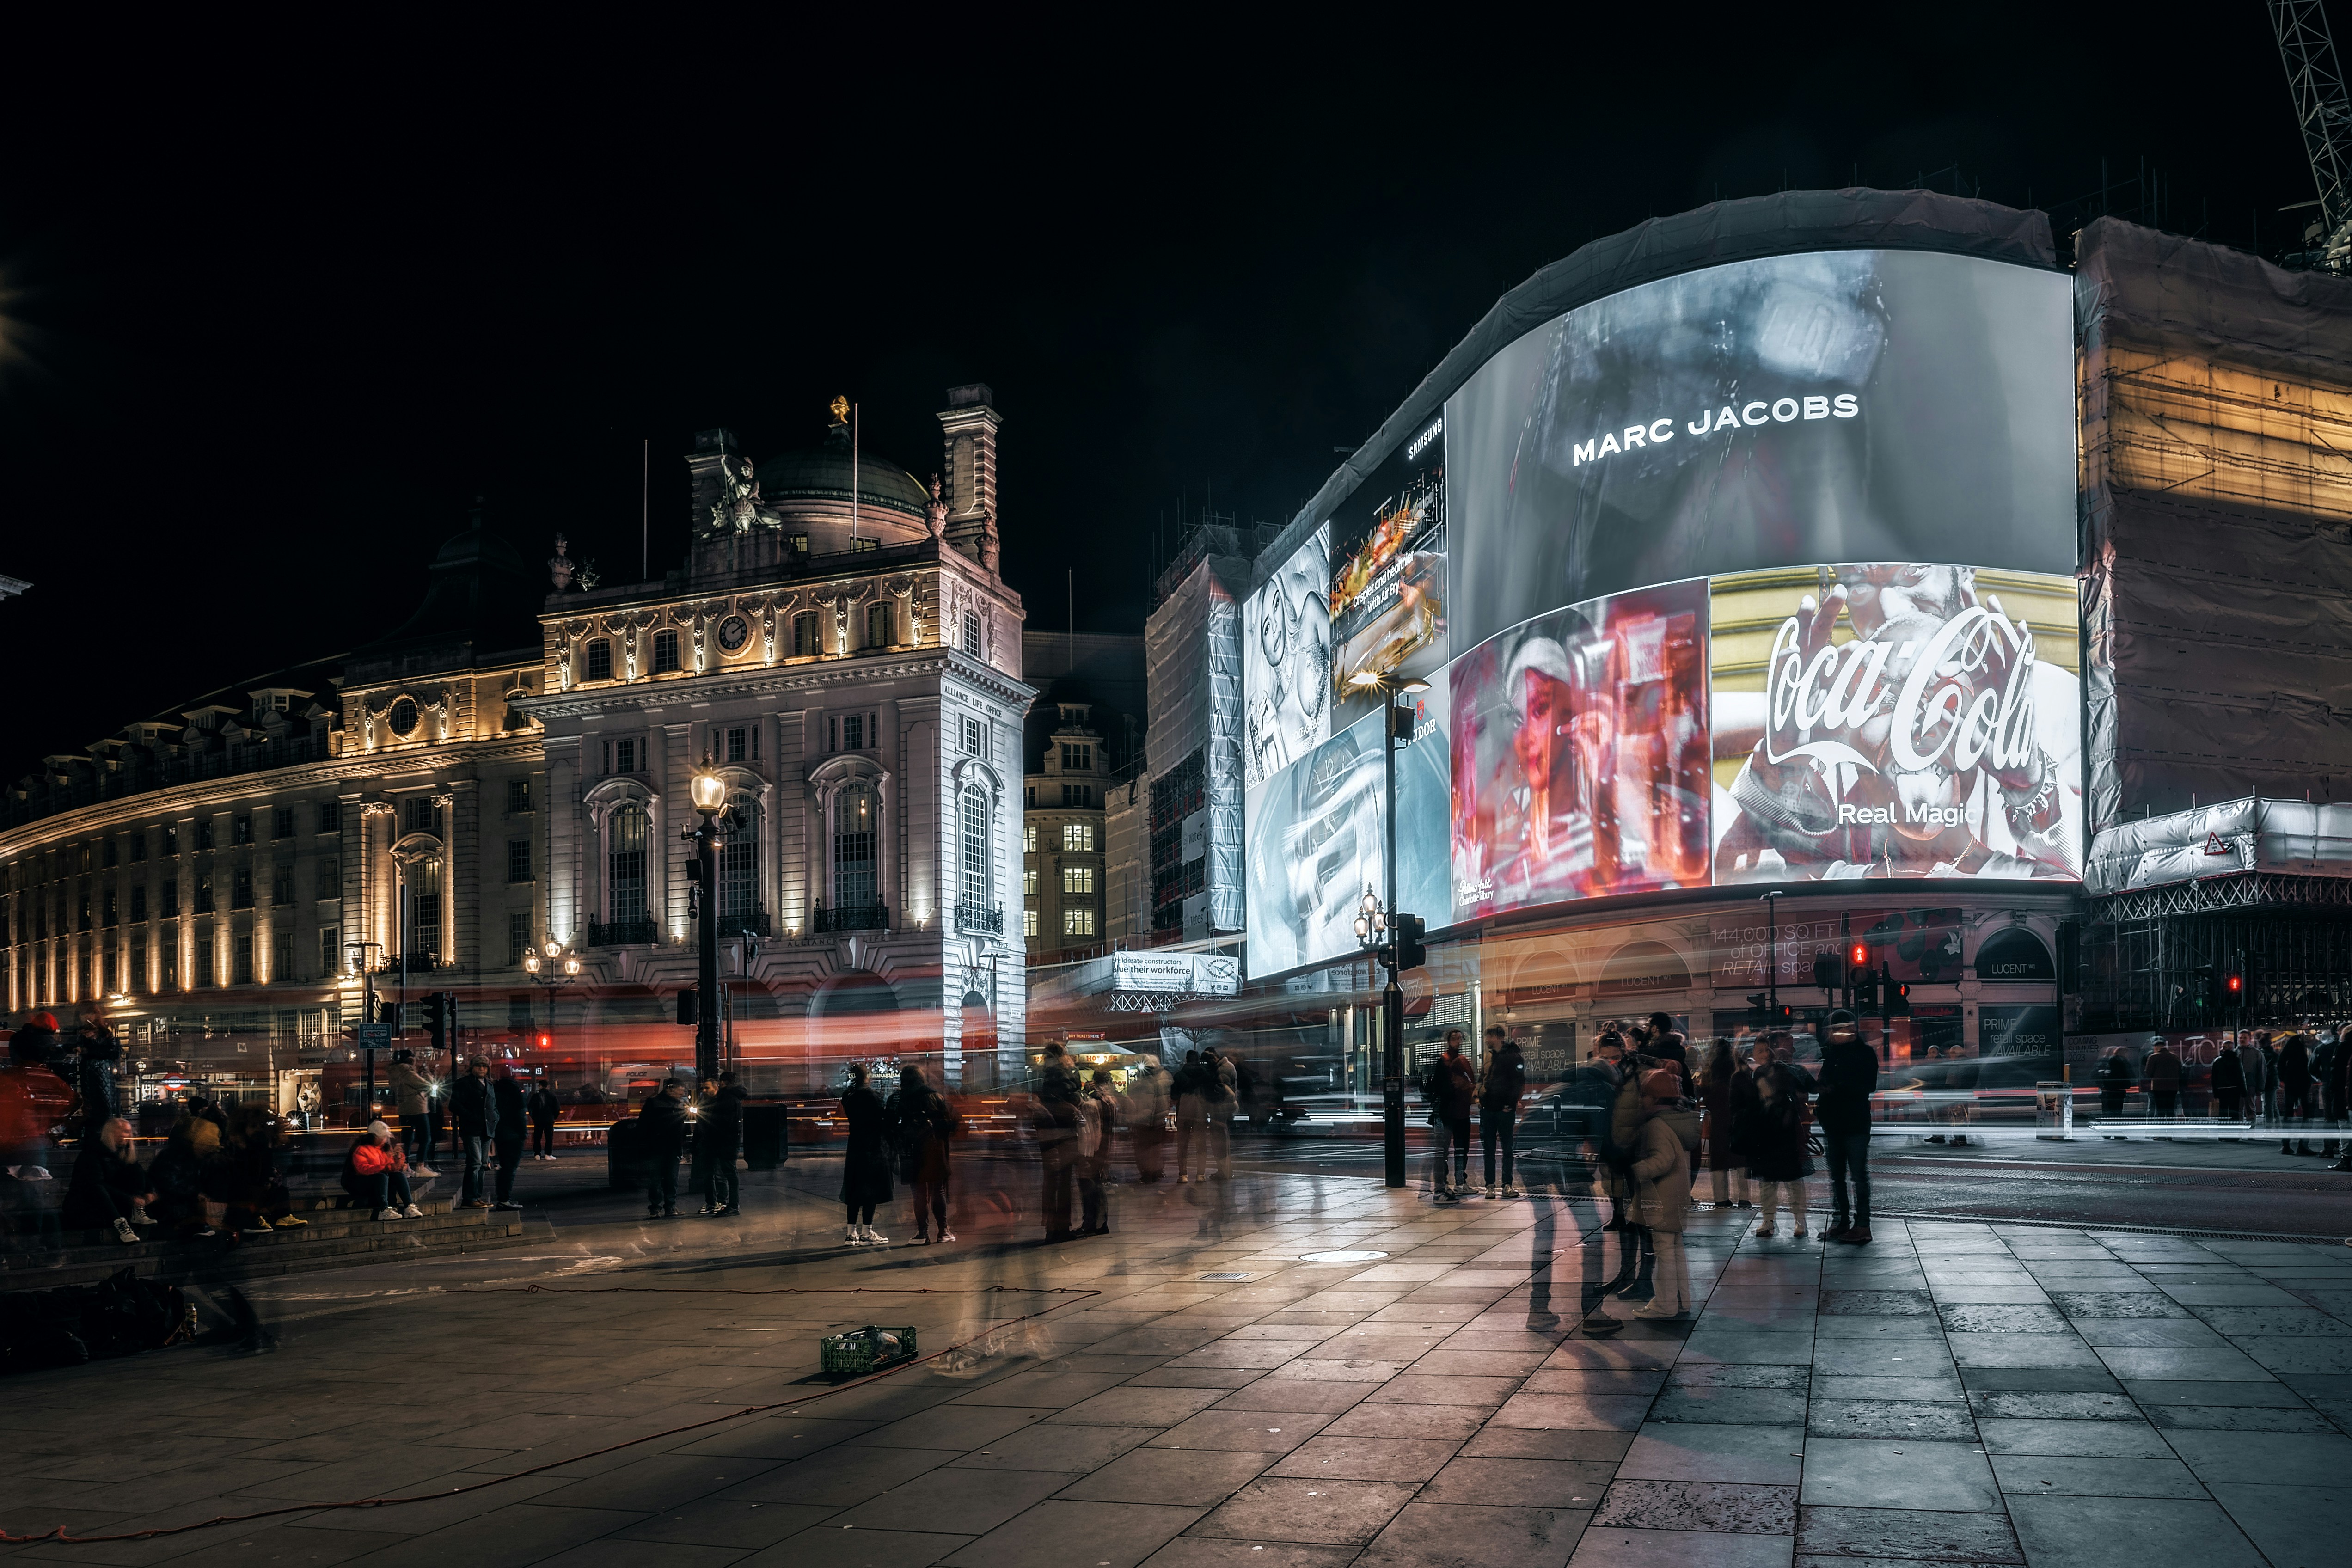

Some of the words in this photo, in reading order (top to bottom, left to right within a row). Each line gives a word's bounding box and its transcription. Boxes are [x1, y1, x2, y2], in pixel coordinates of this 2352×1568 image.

[1573, 418, 1675, 467] MARC
[1687, 394, 1859, 435] JACOBS
[1409, 417, 1442, 460] SAMSUNG
[1375, 571, 1387, 590] and
[1387, 550, 1415, 581] healthier
[1367, 595, 1380, 613] with
[1381, 587, 1390, 604] Air
[1390, 579, 1400, 595] Fry
[1766, 606, 2036, 775] Coca-Cola
[944, 686, 968, 703] ALLIANCE
[973, 698, 983, 709] LIFE
[986, 704, 1002, 718] OFFICE
[1838, 802, 1897, 824] Real
[1905, 802, 1978, 828] Magic
[1459, 894, 1479, 906] Charlotte
[1478, 890, 1494, 900] Tilbury
[1711, 925, 1779, 944] 144,000
[1784, 925, 1809, 940] SQ
[1815, 924, 1836, 938] FT
[788, 938, 838, 947] ALLIANCE
[1731, 944, 1747, 959] of
[1750, 941, 1811, 958] OFFICE
[1130, 965, 1149, 973] their
[1151, 966, 1191, 974] workforce
[1721, 960, 1777, 976] RETAIL
[1782, 961, 1815, 976] spac
[1991, 963, 2027, 974] LUCENT
[1621, 975, 1661, 987] LUCENT
[1531, 984, 1560, 995] LUCENT
[1984, 1018, 2017, 1030] PRIME
[1516, 1036, 1542, 1048] PRIME
[1990, 1032, 2012, 1044] retail
[2015, 1034, 2046, 1046] space
[2068, 1035, 2097, 1046] COMING
[1521, 1049, 1538, 1060] retail
[1540, 1049, 1566, 1061] space
[1995, 1045, 2052, 1057] AVAILABLE
[2068, 1045, 2099, 1054] SUMMER
[2068, 1053, 2086, 1062] 2023
[1525, 1059, 1570, 1072] AVAILABLE
